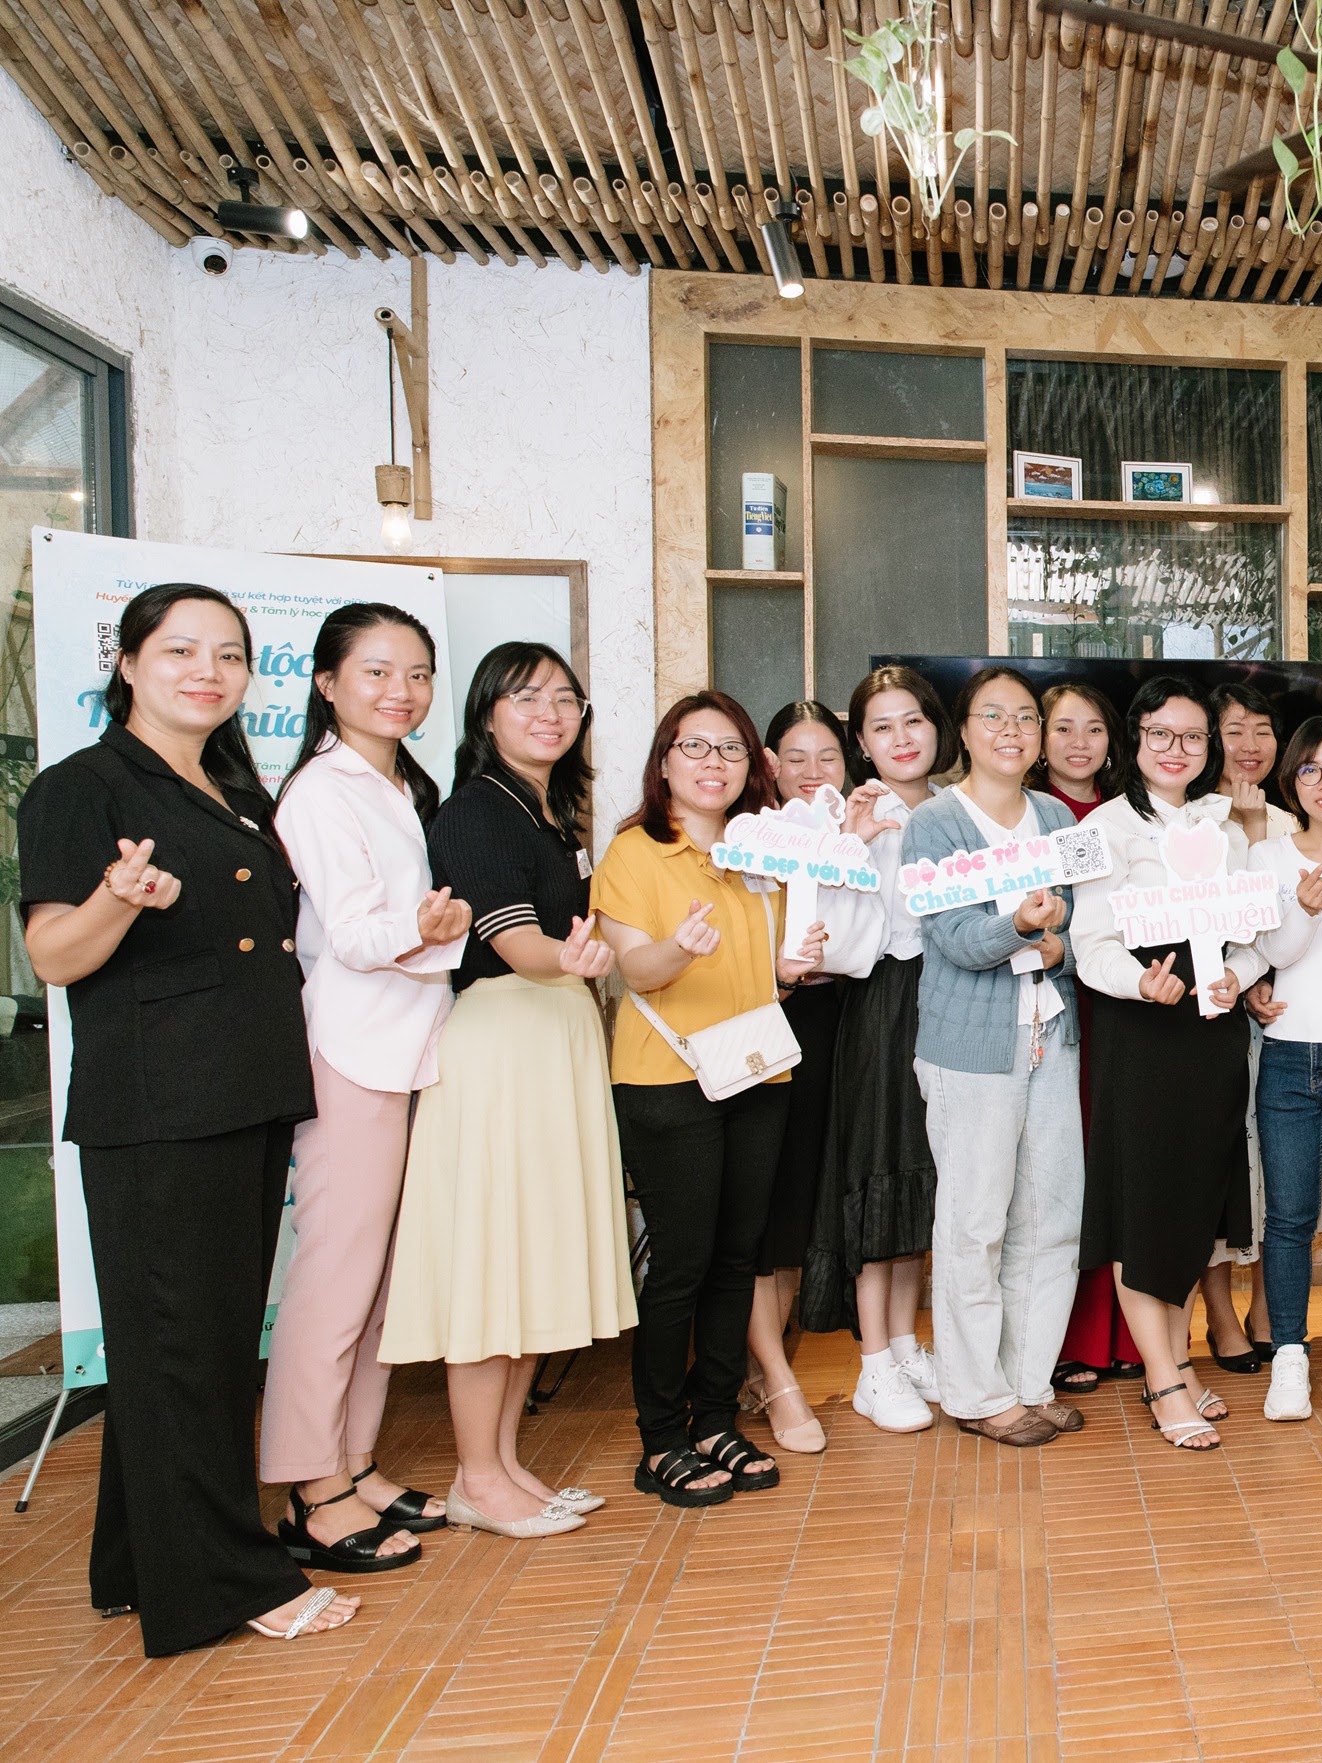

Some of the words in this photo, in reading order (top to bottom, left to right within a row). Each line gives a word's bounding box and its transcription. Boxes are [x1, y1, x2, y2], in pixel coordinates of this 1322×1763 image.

[248, 590, 267, 600] kết
[269, 592, 292, 604] hợp
[294, 594, 323, 606] tuyệt
[261, 606, 287, 616] Tâm
[301, 608, 322, 618] học
[716, 843, 755, 868] TỐT
[762, 855, 799, 878] ĐẸP
[807, 860, 840, 882] VỚI
[847, 867, 877, 888] TÔI
[903, 862, 936, 888] BỘ
[943, 853, 987, 880] TỘC
[992, 842, 1020, 865] TỬ
[1026, 839, 1050, 858] VI
[909, 884, 978, 913] Chữa
[985, 866, 1053, 897] Lành
[1143, 890, 1163, 907] VI
[1226, 873, 1275, 896] LÀNH
[1118, 912, 1182, 945] Tình
[1189, 902, 1278, 944] Duyên
